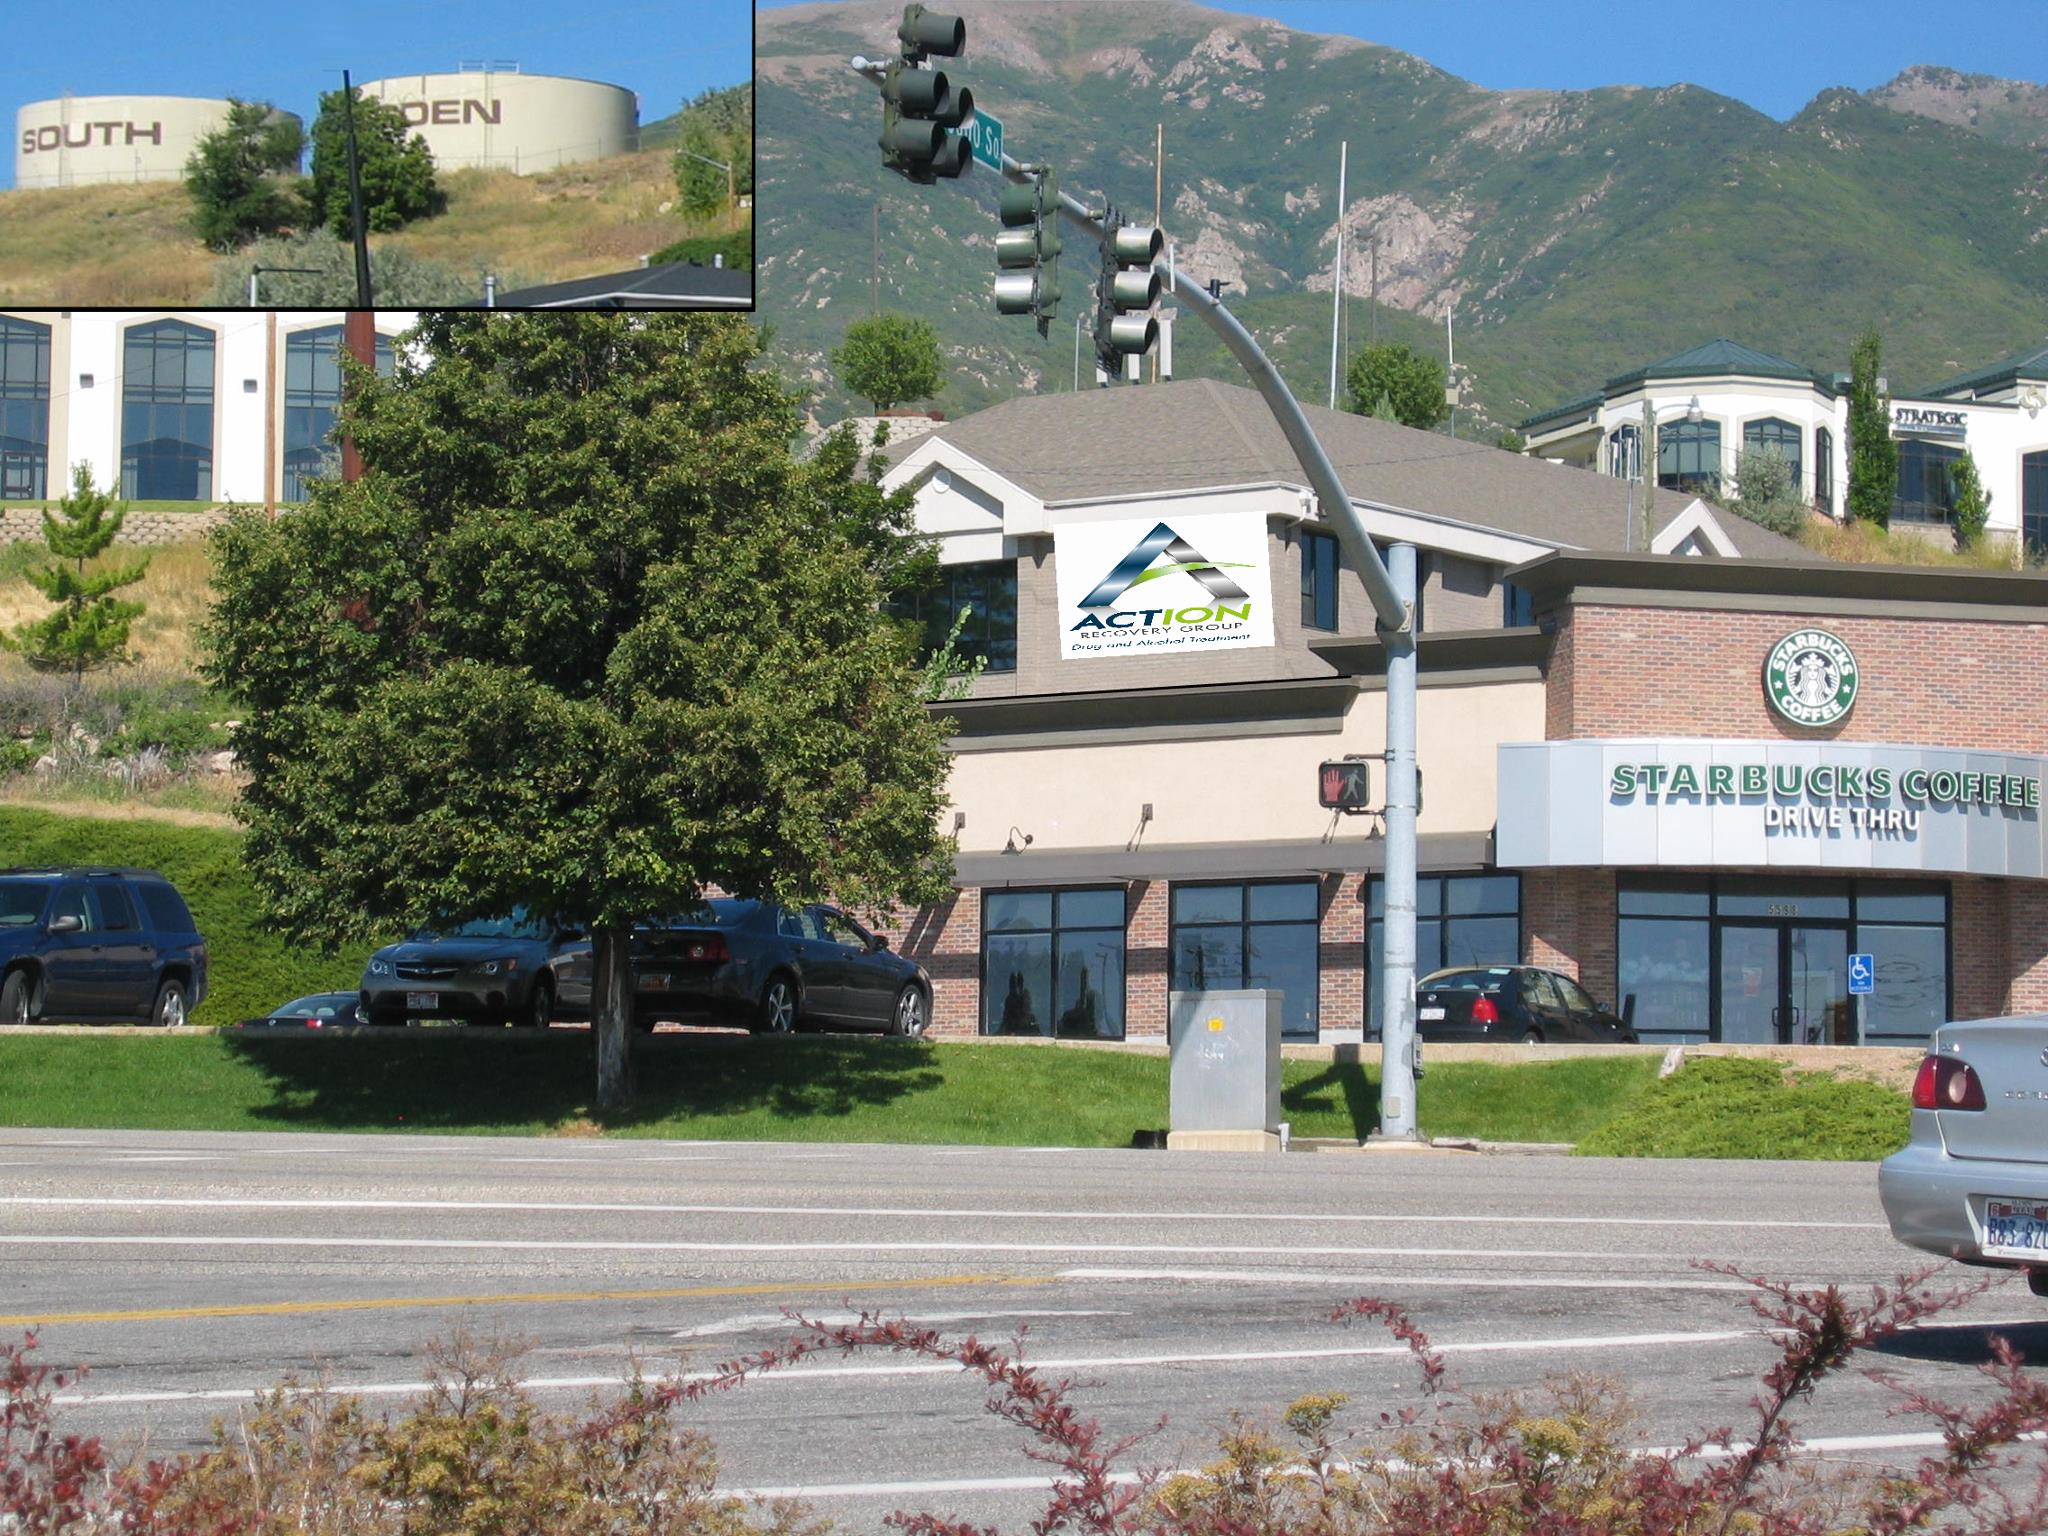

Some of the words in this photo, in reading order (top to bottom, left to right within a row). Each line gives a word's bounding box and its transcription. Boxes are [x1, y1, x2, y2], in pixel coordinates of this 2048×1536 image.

[22, 121, 161, 153] SOUTH
[986, 126, 999, 159] So
[1069, 604, 1252, 632] ACTION
[1081, 627, 1171, 639] RECOVERY
[1180, 623, 1243, 632] GROUP
[1071, 643, 1102, 651] Drug
[1136, 637, 1185, 646] Alcohol
[1190, 634, 1251, 643] Treatment
[1773, 633, 1853, 676] STARBUCKS
[1781, 696, 1843, 721] COFFEE
[1612, 763, 1893, 798] STARBUCKS
[1902, 768, 2041, 808] COFFEE
[1765, 806, 1842, 828] DRIVE
[1850, 808, 1921, 831] THRU
